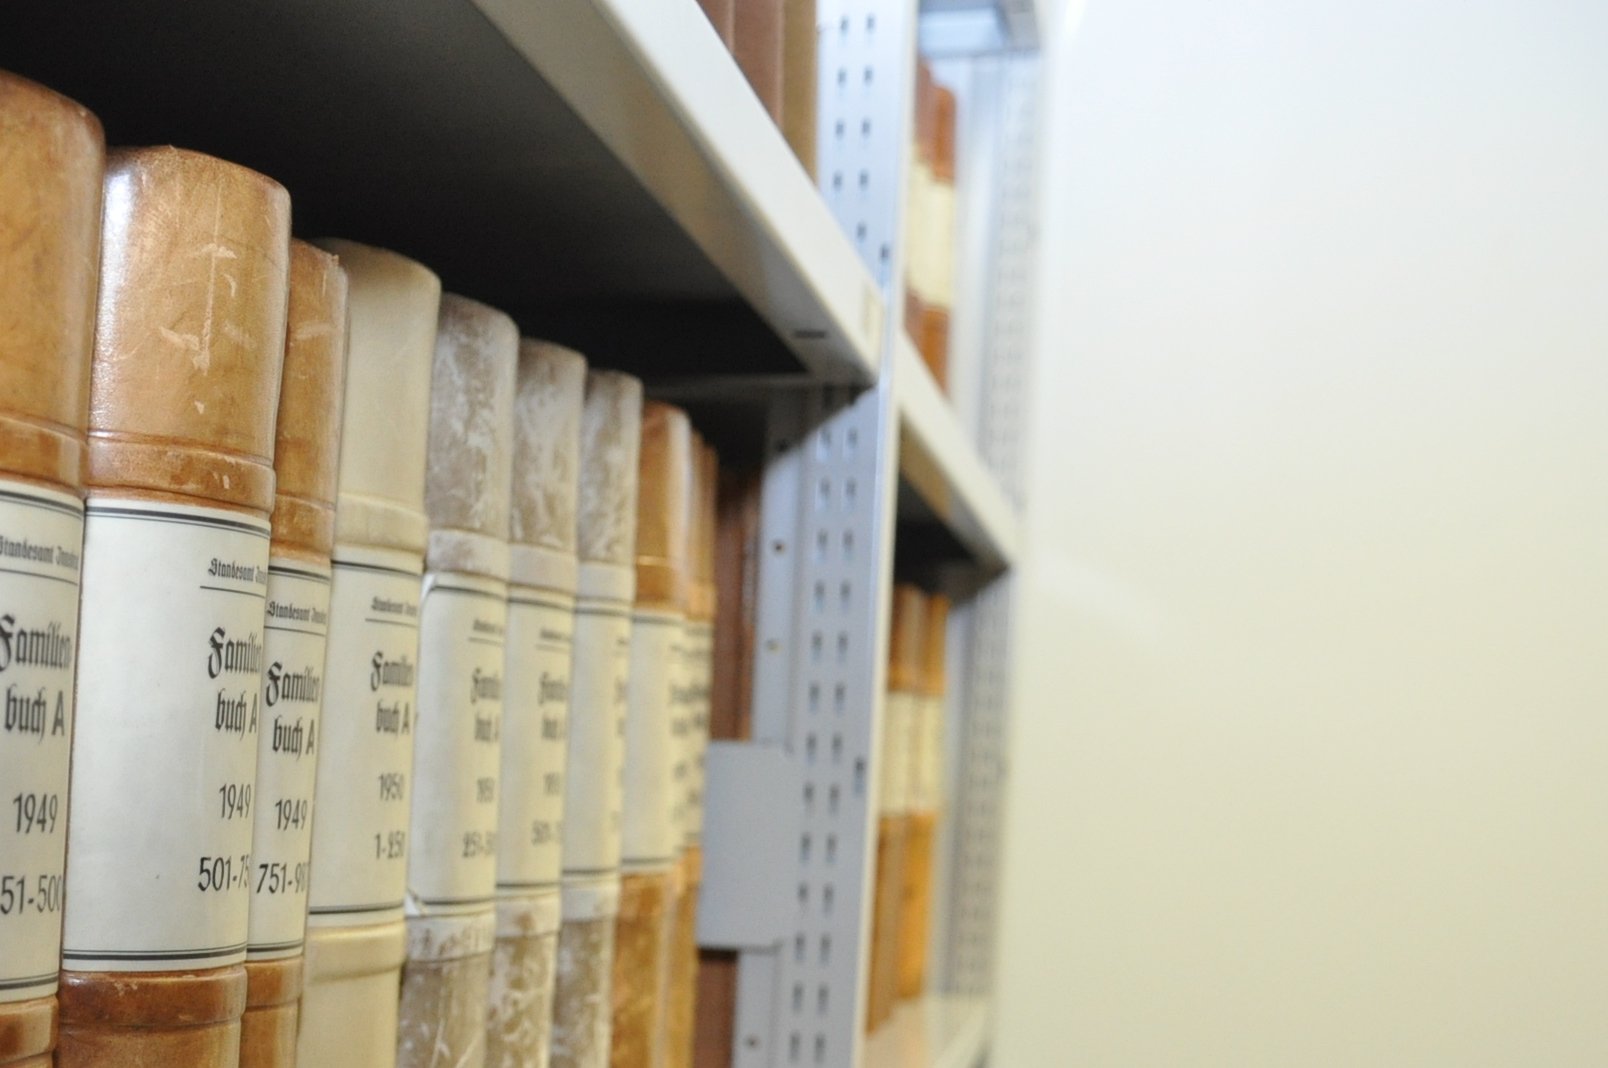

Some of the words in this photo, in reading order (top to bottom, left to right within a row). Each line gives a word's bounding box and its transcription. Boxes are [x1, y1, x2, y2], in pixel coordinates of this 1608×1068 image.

[4, 683, 46, 744] buch
[51, 690, 66, 737] A
[215, 688, 247, 740] buch
[249, 693, 257, 734] A
[401, 703, 410, 734] A
[272, 715, 303, 761] buch
[305, 719, 316, 755] A
[13, 793, 59, 834] 1949
[219, 783, 251, 820] 1949
[275, 798, 307, 831] 1949
